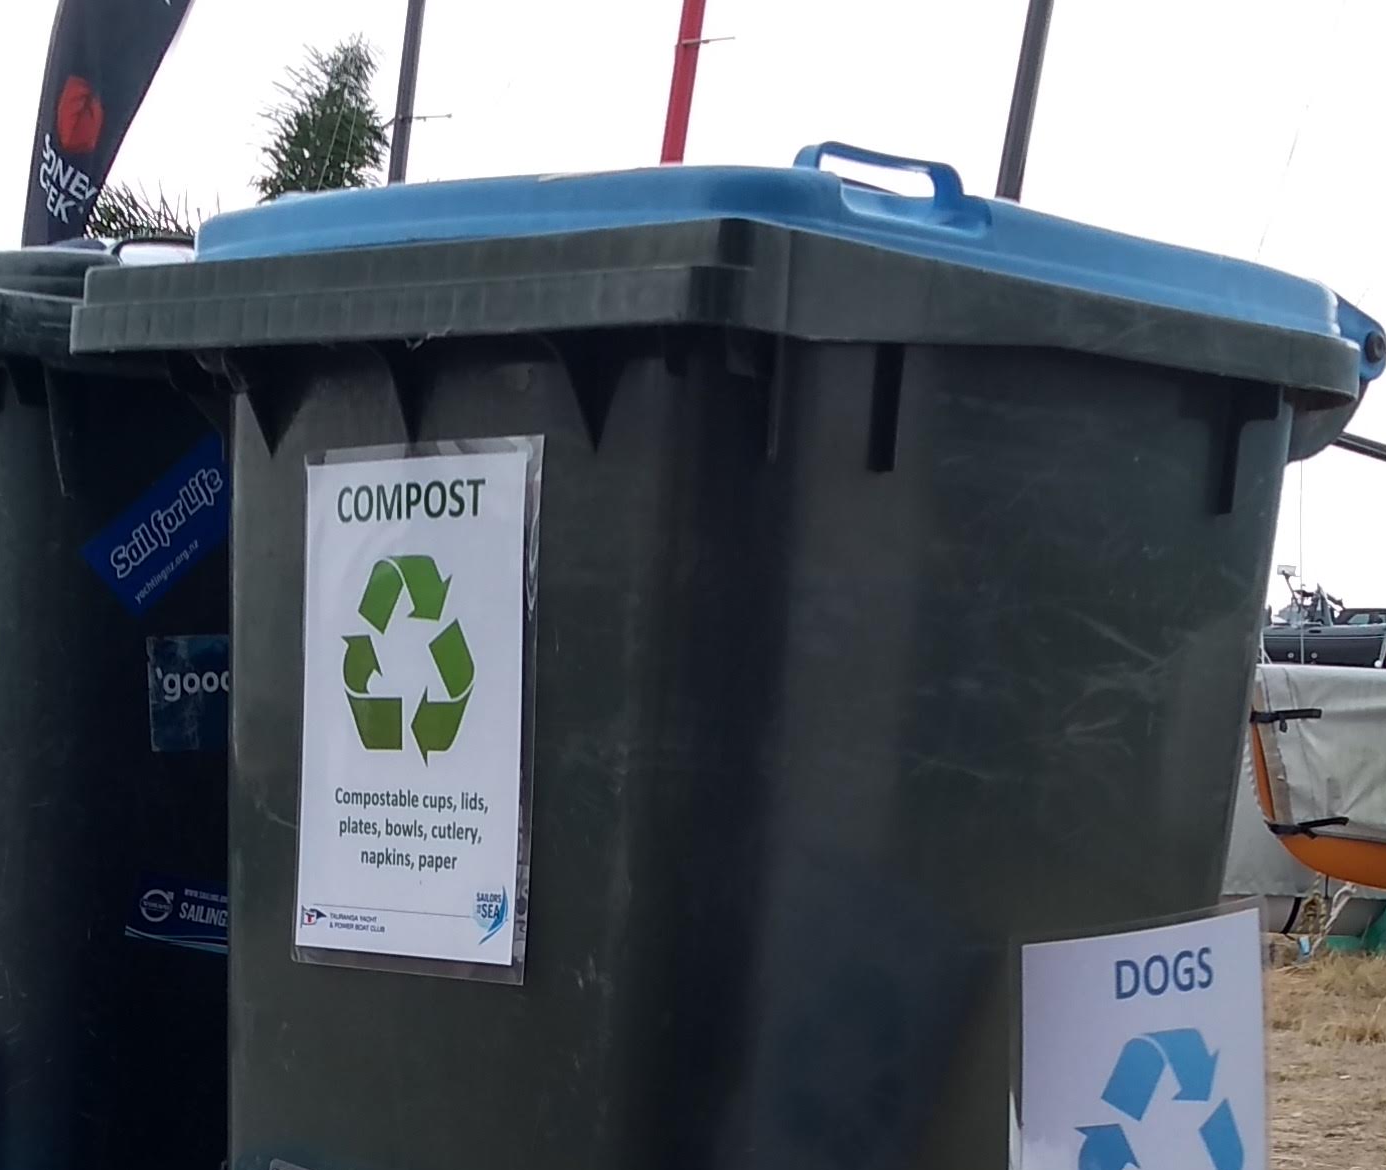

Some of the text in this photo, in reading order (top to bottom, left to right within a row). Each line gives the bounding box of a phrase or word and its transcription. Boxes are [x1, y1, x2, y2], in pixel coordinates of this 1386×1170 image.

[337, 478, 486, 523] COMPOST
[110, 468, 223, 579] Sail for Life
[134, 539, 200, 605] yachtingnz.org.nz
[335, 787, 488, 814] Compostable cups, lids,
[339, 816, 482, 845] plates, bowls, cutlery,
[361, 847, 457, 873] napkins, paper
[476, 892, 501, 903] SAILORS
[481, 903, 500, 919] SEA
[1115, 946, 1213, 1000] DOGS
